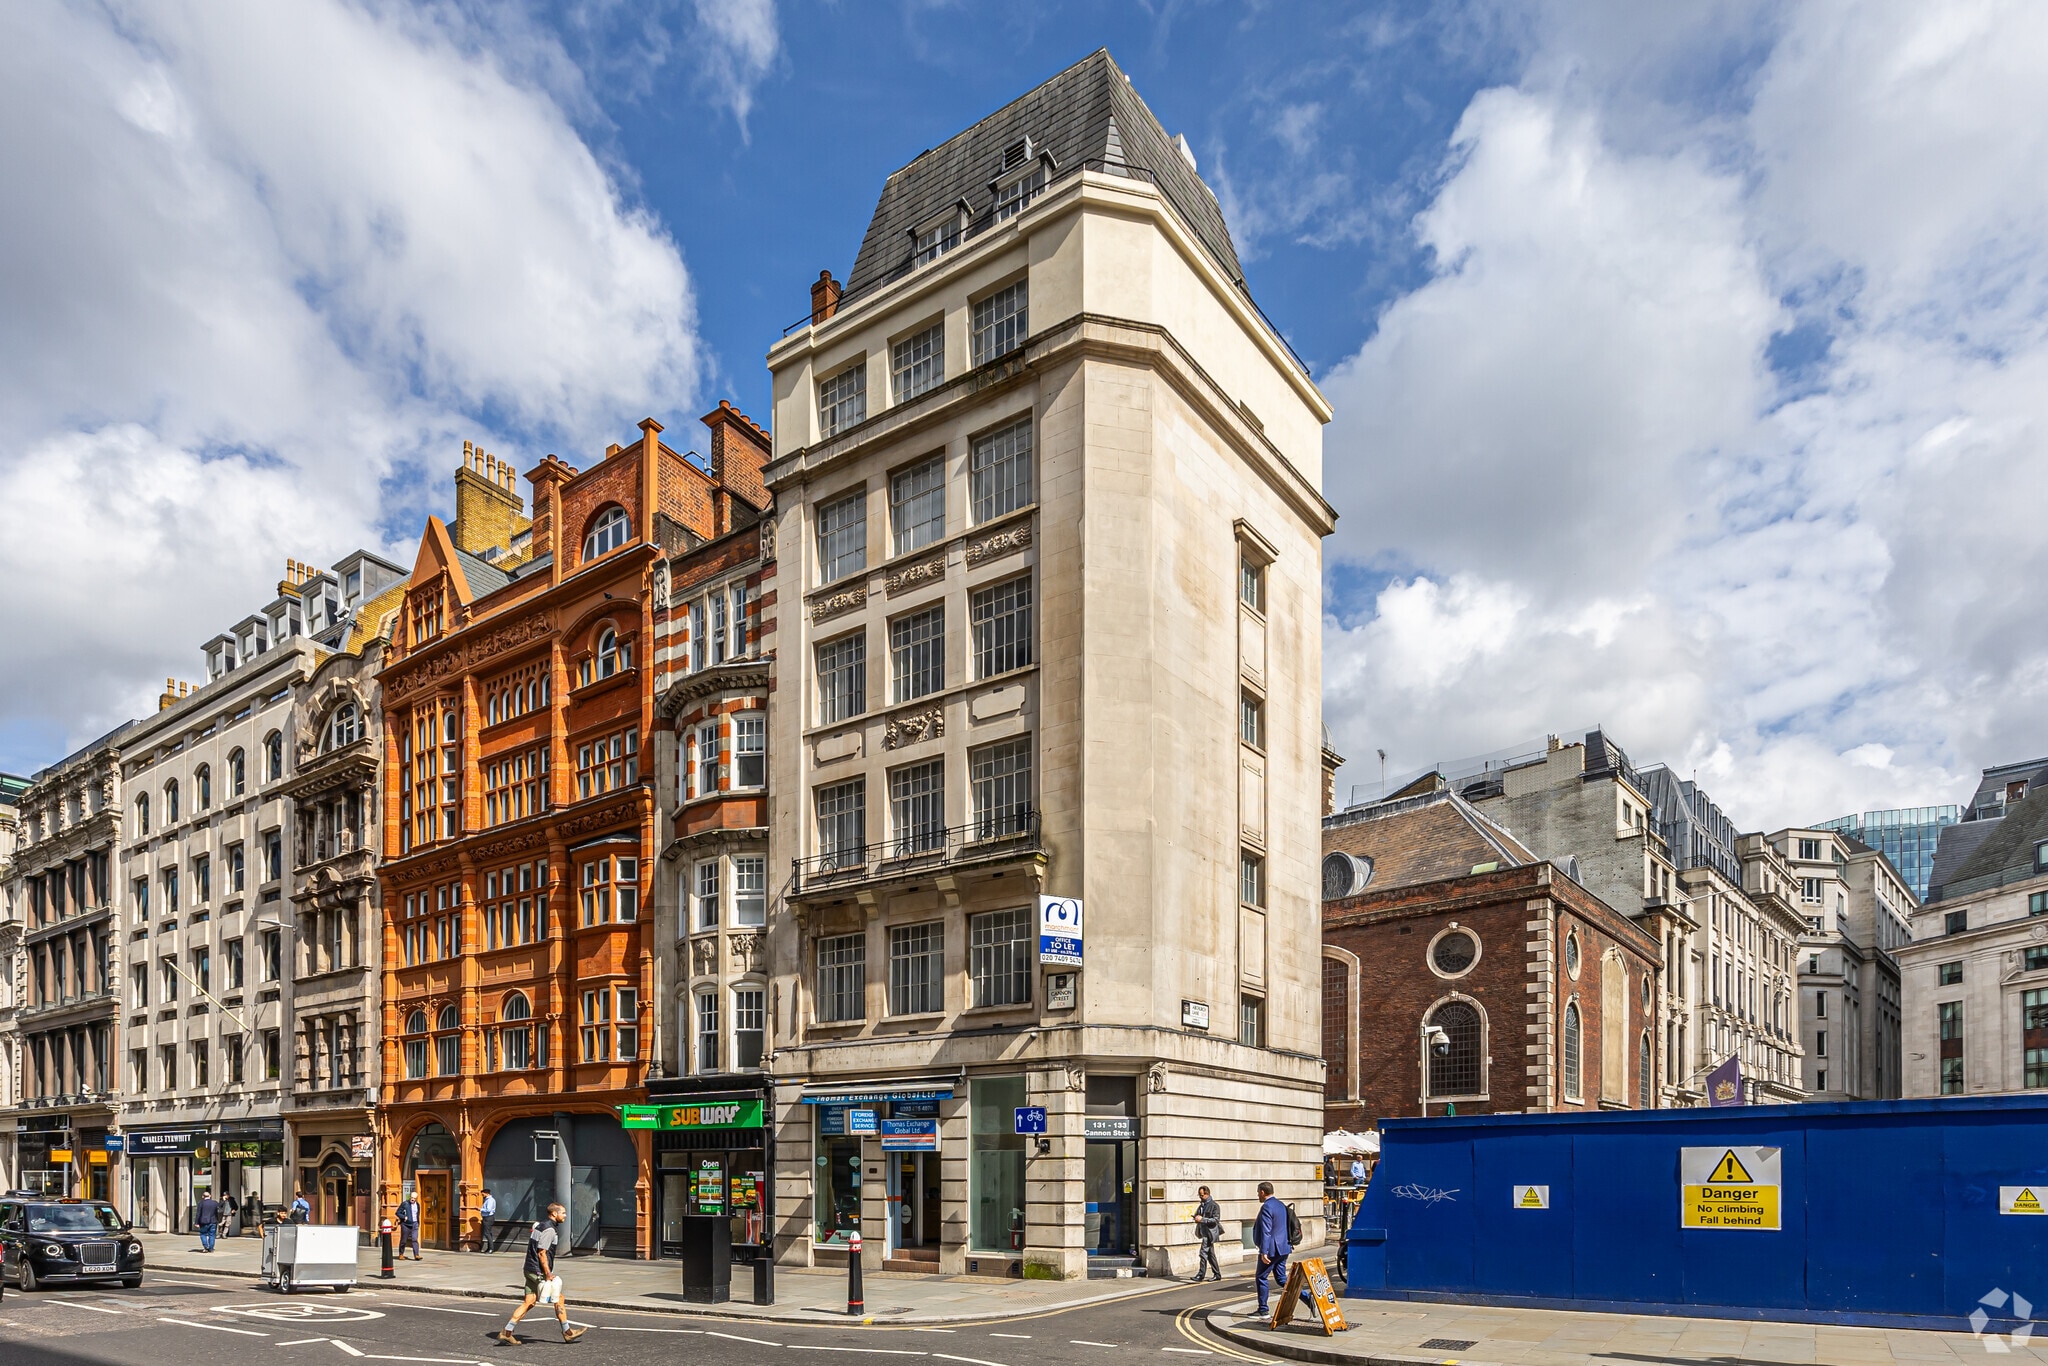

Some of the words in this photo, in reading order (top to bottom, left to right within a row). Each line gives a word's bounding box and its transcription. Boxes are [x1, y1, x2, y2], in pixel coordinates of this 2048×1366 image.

[1064, 942, 1076, 951] LET
[848, 1092, 888, 1101] Exchange
[670, 1106, 740, 1126] SUBWAY
[142, 1135, 163, 1144] CHARLES
[1702, 1188, 1758, 1200] Danger
[1717, 1205, 1764, 1215] climbing
[1724, 1216, 1761, 1224] behind
[1311, 1274, 1330, 1298] Coffee
